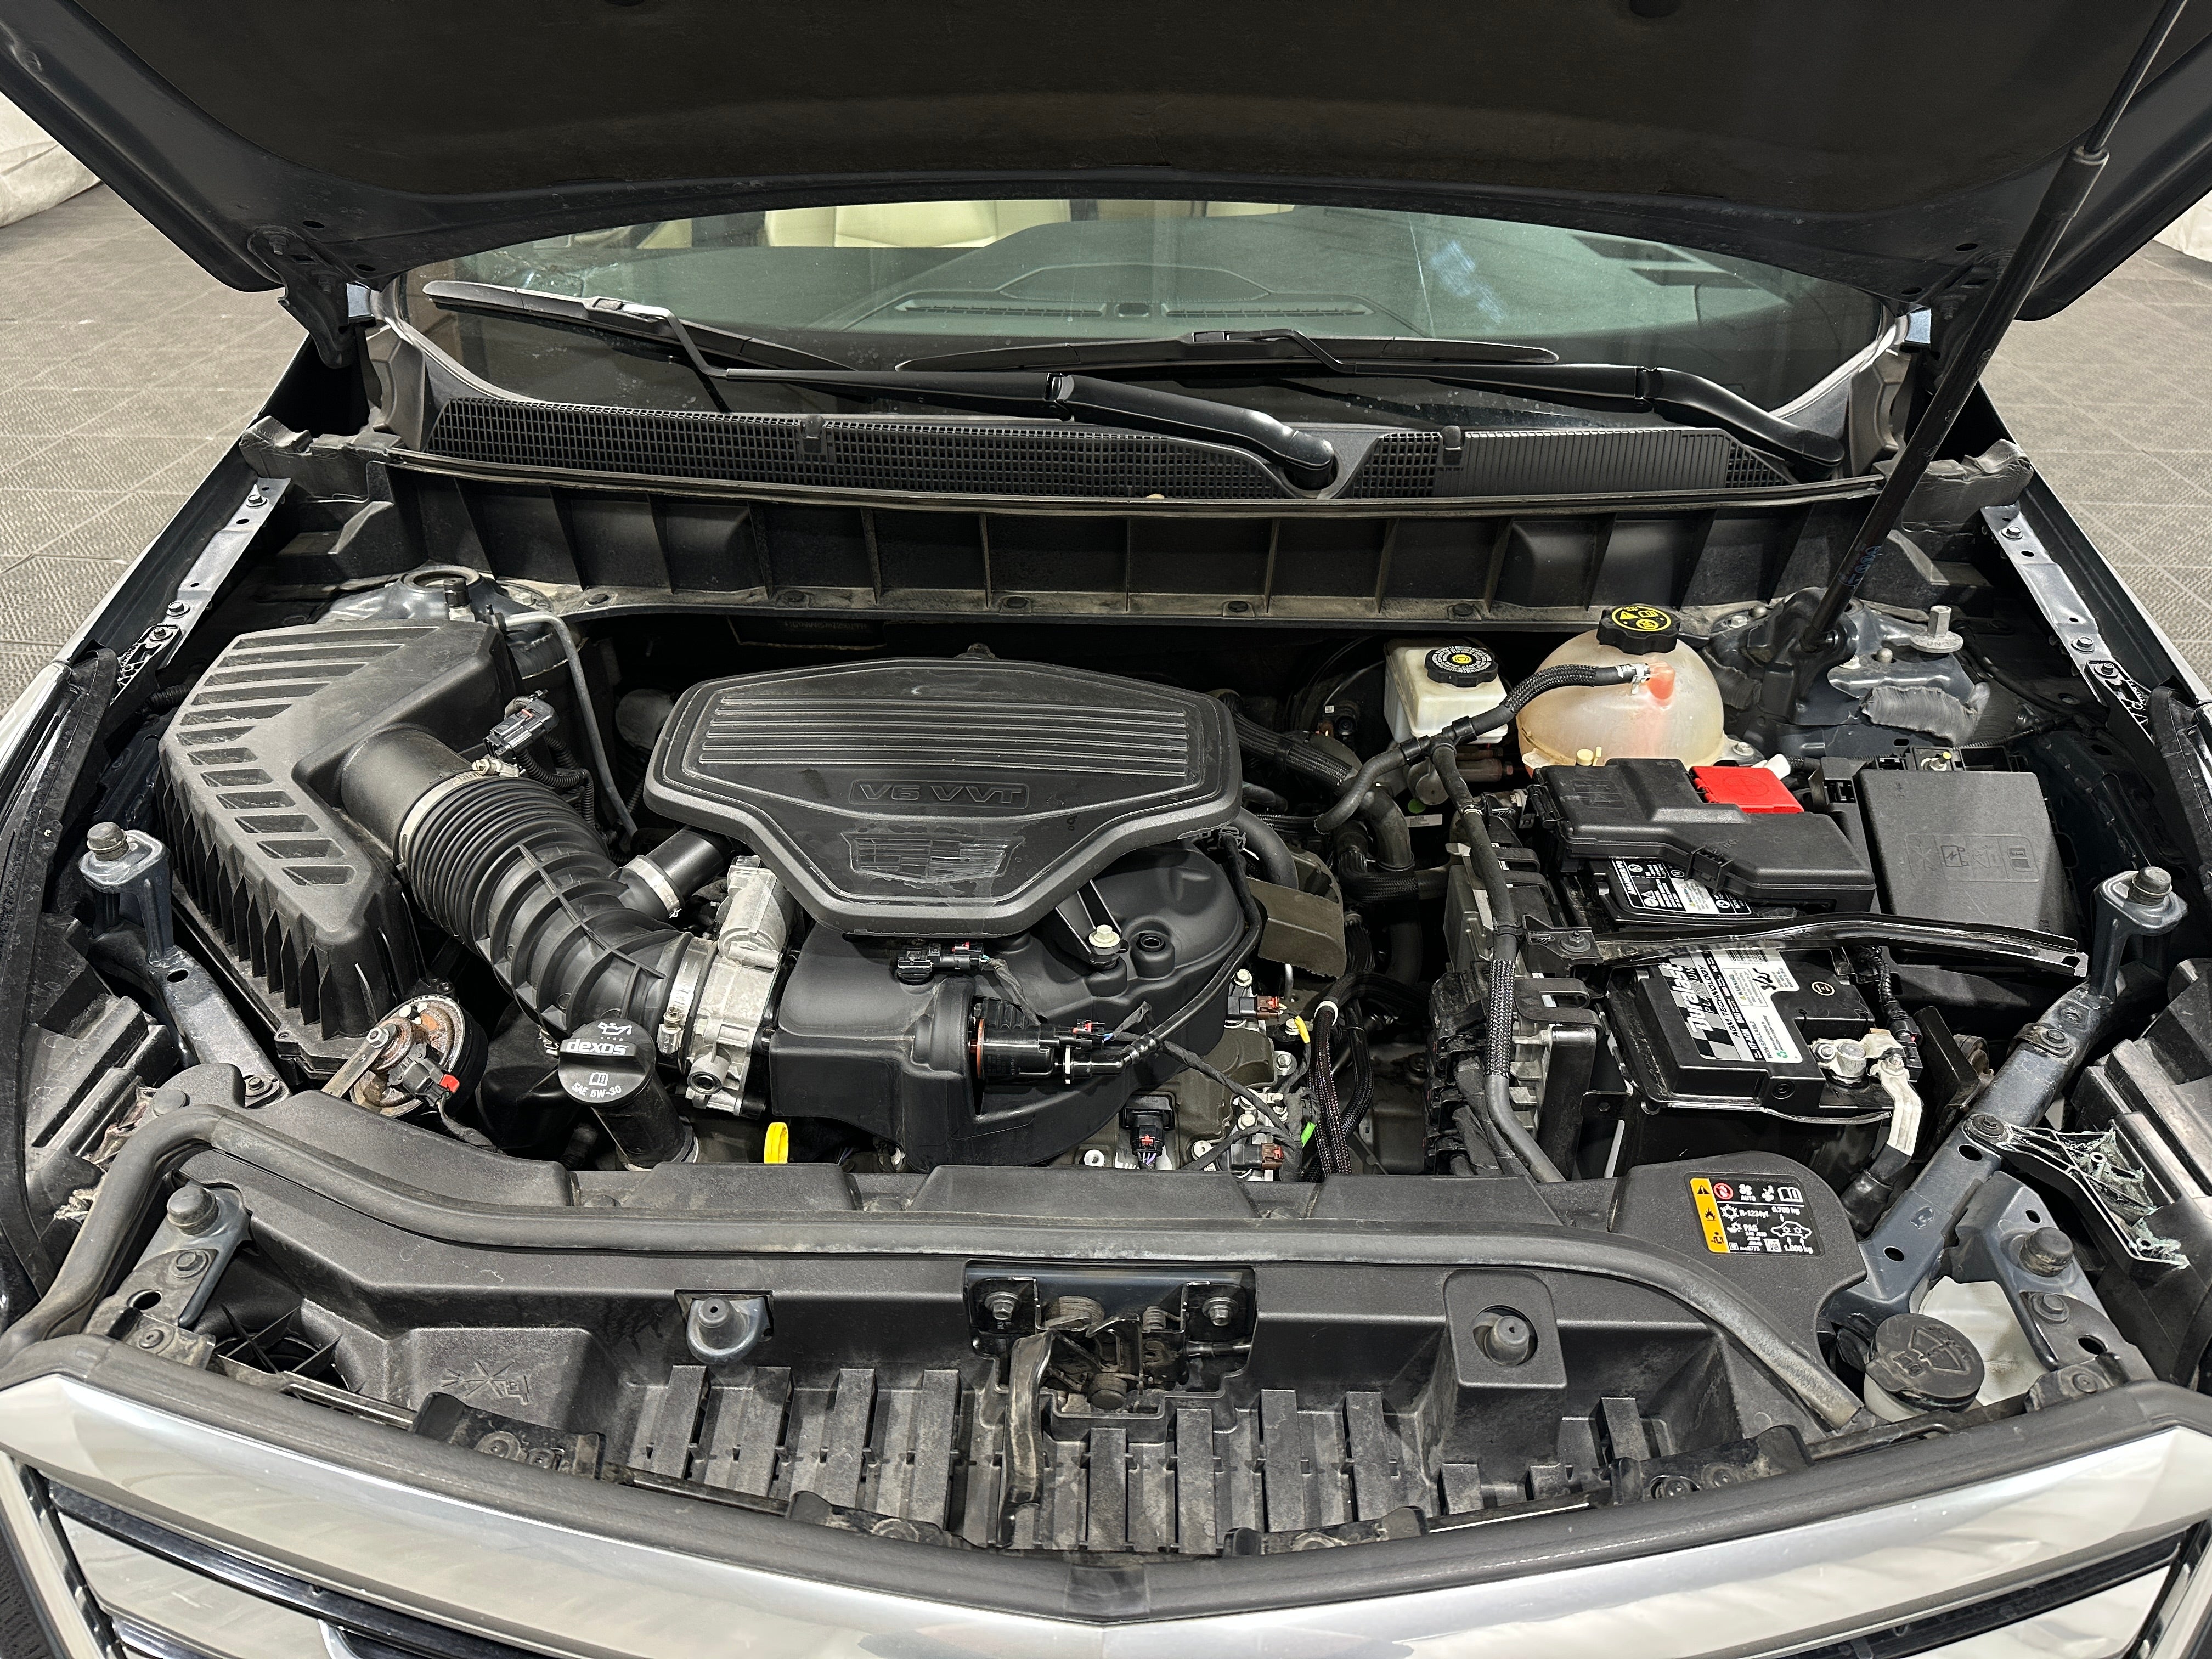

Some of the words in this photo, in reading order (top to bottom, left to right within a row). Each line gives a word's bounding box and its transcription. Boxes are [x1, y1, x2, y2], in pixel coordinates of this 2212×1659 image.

[859, 784, 921, 801] V6
[930, 785, 1022, 804] VVT
[1615, 860, 1634, 890] DANGER/PO
[1661, 962, 1714, 1033] Duralast
[1684, 966, 1715, 1013] PLATINUM
[1697, 964, 1730, 1017] TECHNOLOGY
[1724, 1018, 1741, 1039] AGM
[566, 1038, 629, 1056] dexos
[1749, 1020, 1773, 1058] NON-SPILLABLE
[571, 1082, 589, 1096] SAE
[590, 1085, 622, 1098] 5W-30
[1791, 1207, 1801, 1215] kg
[1743, 1224, 1758, 1232] PAG
[1803, 1245, 1813, 1254] kg
